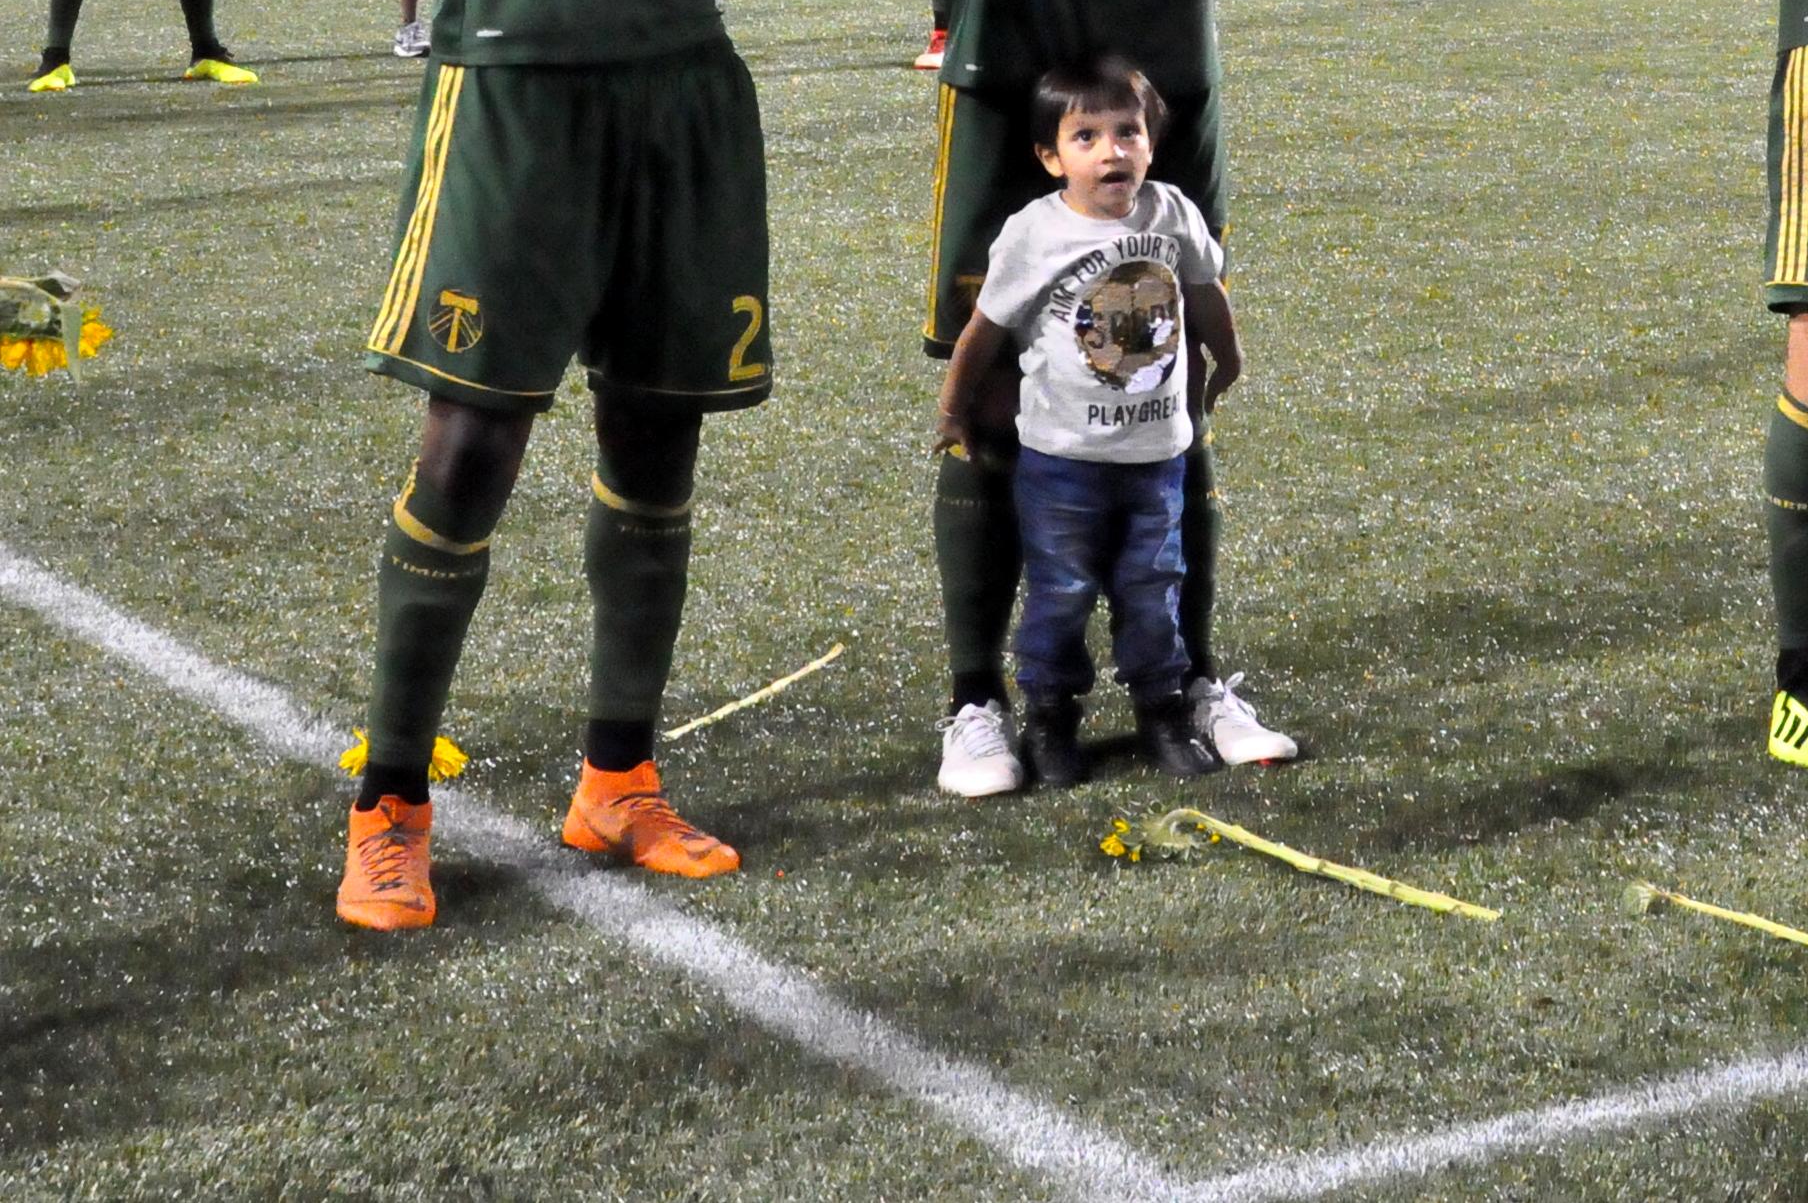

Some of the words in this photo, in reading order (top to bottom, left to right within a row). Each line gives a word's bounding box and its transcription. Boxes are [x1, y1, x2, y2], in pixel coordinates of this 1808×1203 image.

[1050, 282, 1077, 324] AIM
[1071, 249, 1111, 285] FOR
[1112, 233, 1163, 260] YOUR
[728, 295, 765, 382] 2
